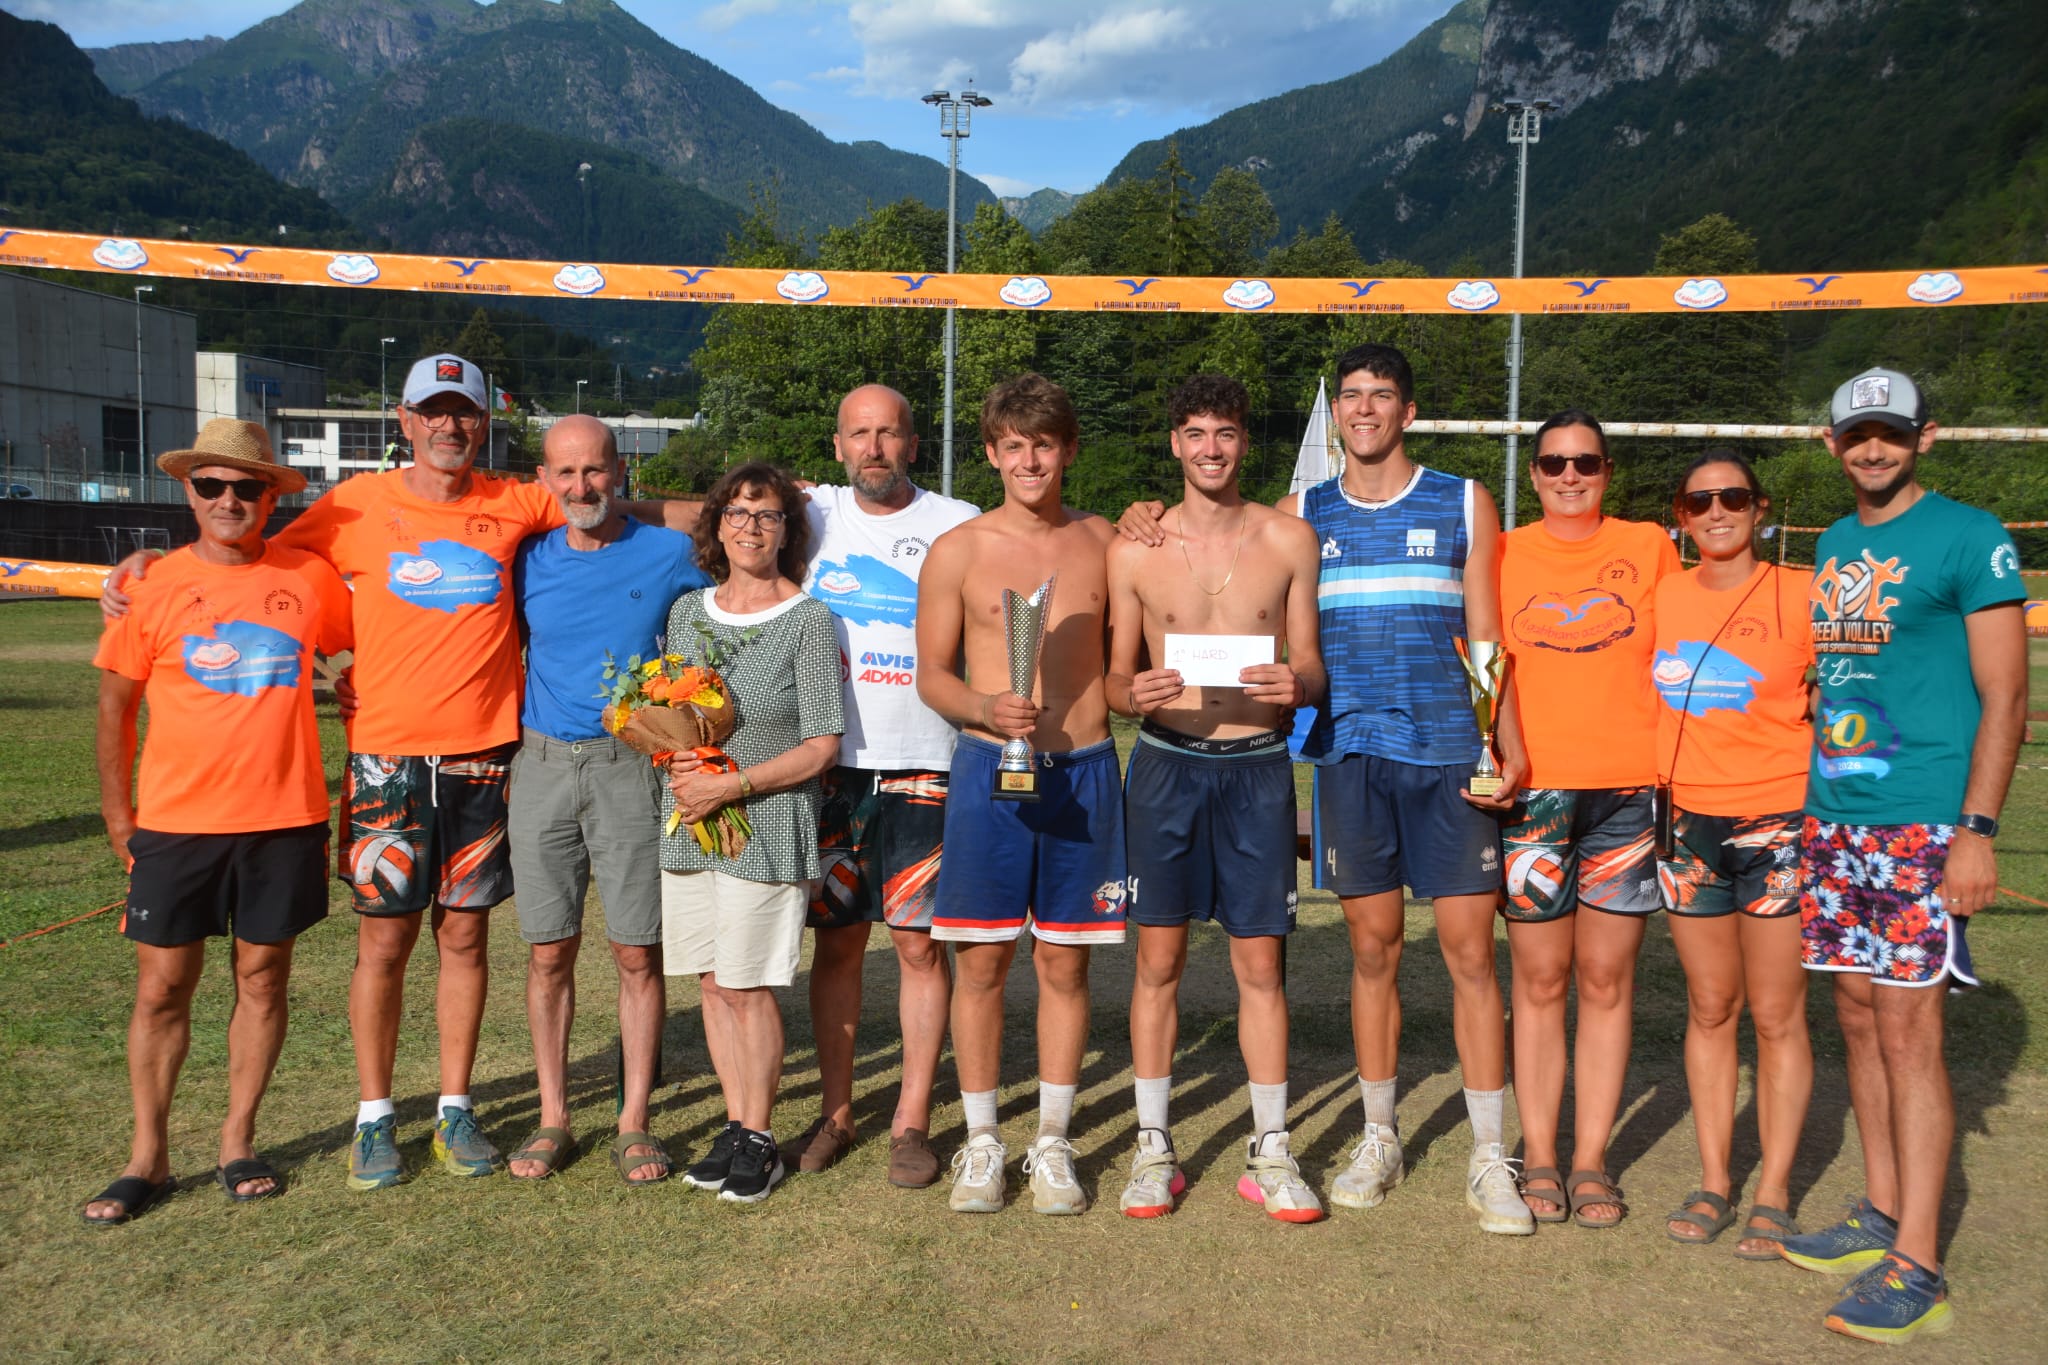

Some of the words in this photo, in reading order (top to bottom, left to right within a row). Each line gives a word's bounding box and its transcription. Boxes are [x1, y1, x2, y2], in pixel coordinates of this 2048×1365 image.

[478, 524, 489, 533] 27
[892, 538, 909, 558] CENTRO
[911, 536, 930, 551] PALLA
[906, 547, 919, 556] 27
[1406, 547, 1435, 557] ARG
[2006, 558, 2017, 569] 2
[1611, 570, 1624, 579] 27
[278, 601, 289, 610] 27
[1739, 628, 1754, 636] 27
[1811, 622, 1840, 641] REEN
[1844, 622, 1890, 642] VOLLEY
[860, 651, 914, 669] AVIS
[1192, 648, 1228, 660] HARD
[857, 669, 912, 686] ADMO
[1179, 738, 1210, 750] NIKE
[1249, 734, 1276, 748] NIKE
[1327, 846, 1337, 876] 4
[1128, 874, 1139, 904] 4
